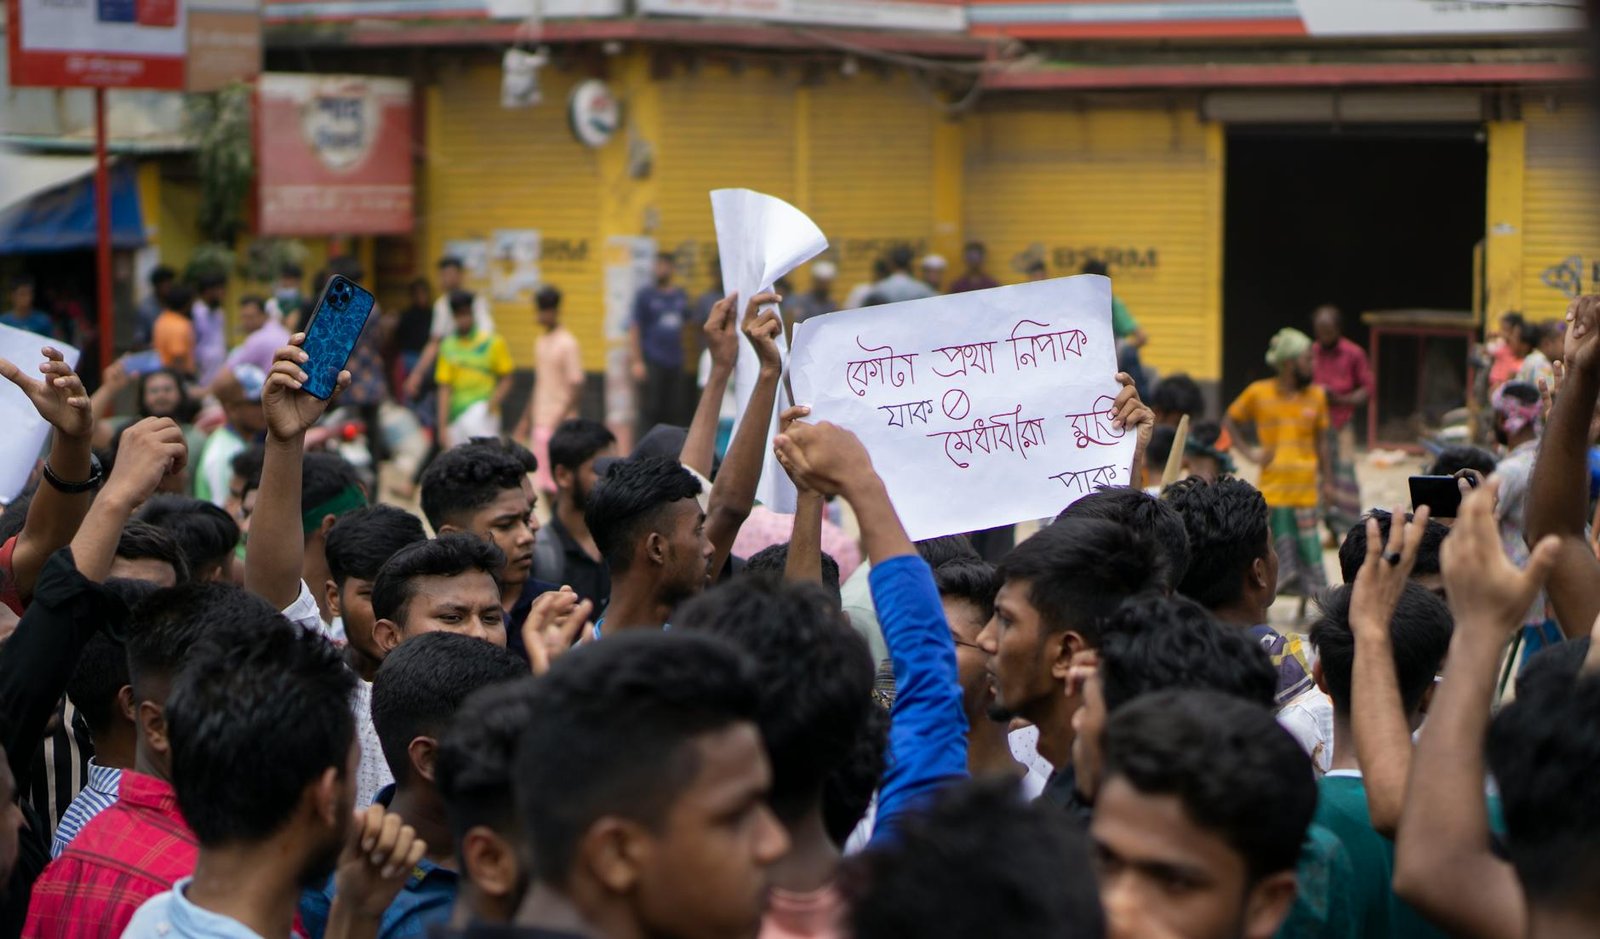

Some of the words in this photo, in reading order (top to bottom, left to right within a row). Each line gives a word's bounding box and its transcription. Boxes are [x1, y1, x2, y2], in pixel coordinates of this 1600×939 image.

[847, 335, 919, 396] কোটা
[931, 341, 998, 377] প্রথা
[877, 399, 933, 428] যাক
[926, 404, 1046, 468] মেধাবীরা
